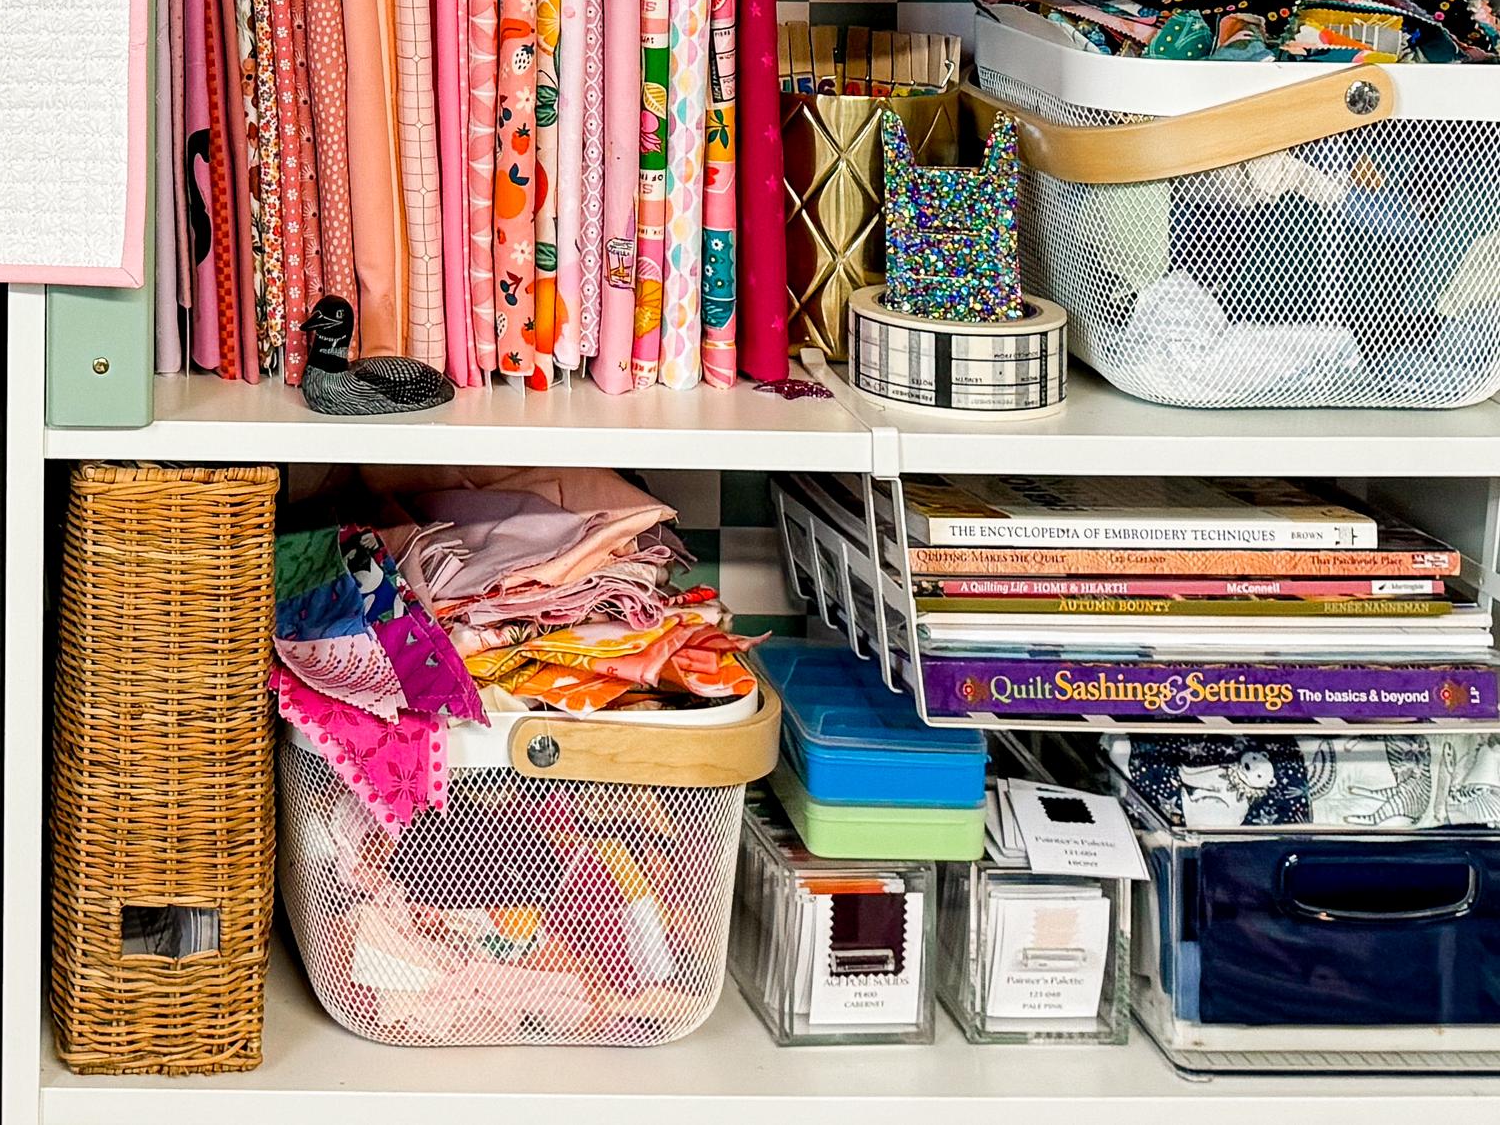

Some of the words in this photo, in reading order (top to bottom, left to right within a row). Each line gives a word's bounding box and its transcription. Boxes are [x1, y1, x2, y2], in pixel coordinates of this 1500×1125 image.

[950, 525, 976, 537] THE
[980, 526, 1080, 539] ENCYCLOPEDIA
[1084, 527, 1101, 540] OF
[1104, 527, 1188, 541] EMBROIDERY
[1191, 529, 1276, 543] TECHNIQUES
[1291, 531, 1324, 540] BROWN
[960, 582, 969, 593] A
[970, 582, 1009, 595] Quilting
[1010, 581, 1029, 593] Life
[1033, 583, 1068, 594] HOME
[1069, 583, 1079, 594] &
[1081, 583, 1128, 594] HEARTH
[1226, 582, 1281, 594] McConnell
[1059, 600, 1115, 613] AUTUMN
[1118, 601, 1172, 613] BOUNTY
[1364, 600, 1430, 613] NANNEMAN
[990, 675, 1052, 703] Quilt
[1054, 670, 1173, 710] Sashings
[1160, 675, 1192, 715] &
[1184, 672, 1294, 711] Settings
[1297, 688, 1322, 702] The
[1325, 689, 1368, 703] basics
[1368, 690, 1379, 703] &
[1381, 690, 1429, 706] beyond
